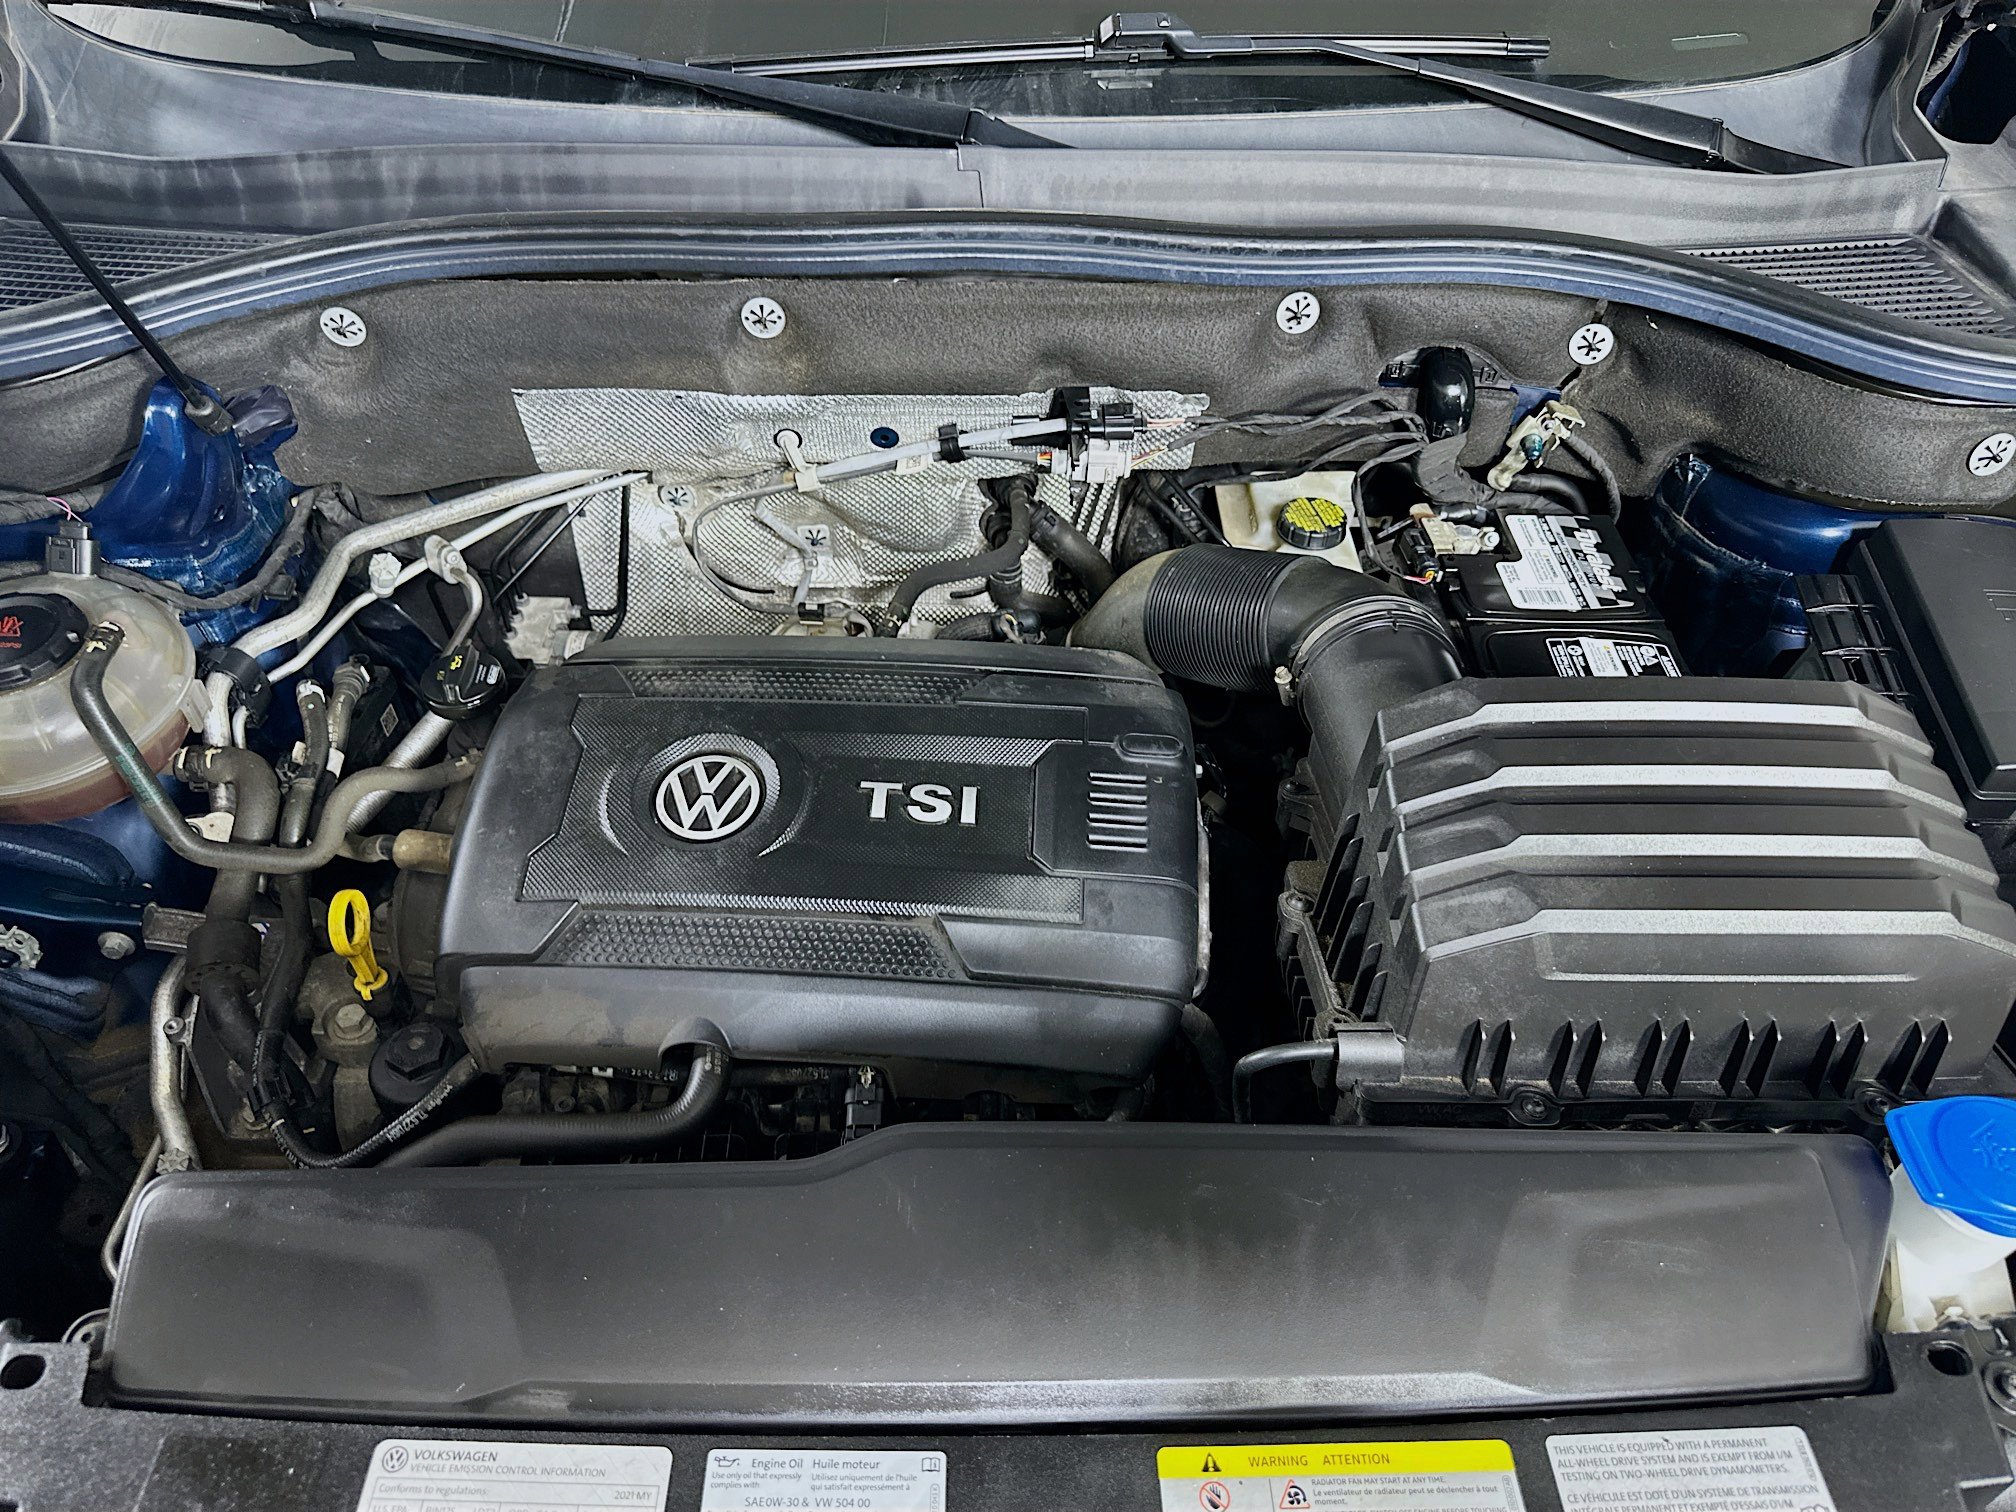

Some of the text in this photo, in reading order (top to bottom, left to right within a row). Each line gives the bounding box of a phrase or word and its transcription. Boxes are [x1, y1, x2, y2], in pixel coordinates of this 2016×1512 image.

[1573, 529, 1623, 592] Duralast
[860, 780, 979, 826] TSI
[1553, 1438, 1767, 1455] THIS VEHICLE IS EQUIPPED WITH A PERMANENT
[414, 1449, 498, 1462] VOLKSWAGEN
[1248, 1453, 1391, 1468] WARNING ATTENTION
[1557, 1458, 1611, 1469] ALL-WHEEL
[1611, 1456, 1640, 1467] DRIVE
[1642, 1455, 1676, 1465] SYSTEM
[1678, 1453, 1699, 1463] AND
[1701, 1453, 1710, 1462] IS
[1711, 1452, 1747, 1463] EXEMPT
[1748, 1450, 1775, 1461] FROM
[751, 1458, 804, 1470] Engine Oil
[812, 1458, 881, 1470] Huile moteur
[411, 1463, 607, 1478] VEHICLE EMISSION CONTROL INFORMATION
[726, 1472, 742, 1481] only
[769, 1472, 802, 1481] expressly
[1560, 1472, 1601, 1482] TESTING
[1602, 1470, 1618, 1480] ON
[1619, 1468, 1679, 1479] TWO-WHEEL
[1680, 1466, 1710, 1477] DRIVE
[811, 1473, 918, 1483] Utilisez uniquement de l'huile
[1311, 1478, 1347, 1486] RADIATOR
[1363, 1477, 1379, 1485] MAY
[1379, 1476, 1401, 1484] START
[1402, 1476, 1411, 1484] AT
[1412, 1476, 1426, 1484] ANY
[378, 1483, 423, 1494] Conforms
[424, 1484, 434, 1494] to
[710, 1482, 742, 1490] complies
[810, 1483, 823, 1492] qui
[824, 1483, 852, 1491] satisfait
[853, 1483, 905, 1492] expressément
[1313, 1489, 1322, 1497] Le
[1323, 1488, 1362, 1496] ventilateur
[1374, 1487, 1407, 1495] radiateur
[1408, 1487, 1425, 1496] peut
[1436, 1486, 1475, 1494] déclencher
[1567, 1493, 1580, 1504] CE
[1579, 1491, 1627, 1503] VÉHICULE
[1627, 1491, 1643, 1502] EST
[1644, 1489, 1670, 1501] DOTÉ
[1671, 1488, 1696, 1500] D'UN
[1736, 1487, 1750, 1496] DE
[1751, 1484, 1820, 1496] TRANSMISSION
[801, 1497, 810, 1507] &
[815, 1497, 833, 1507] VW
[835, 1498, 854, 1508] 504
[857, 1498, 871, 1508] 00
[1679, 1502, 1690, 1512] ET
